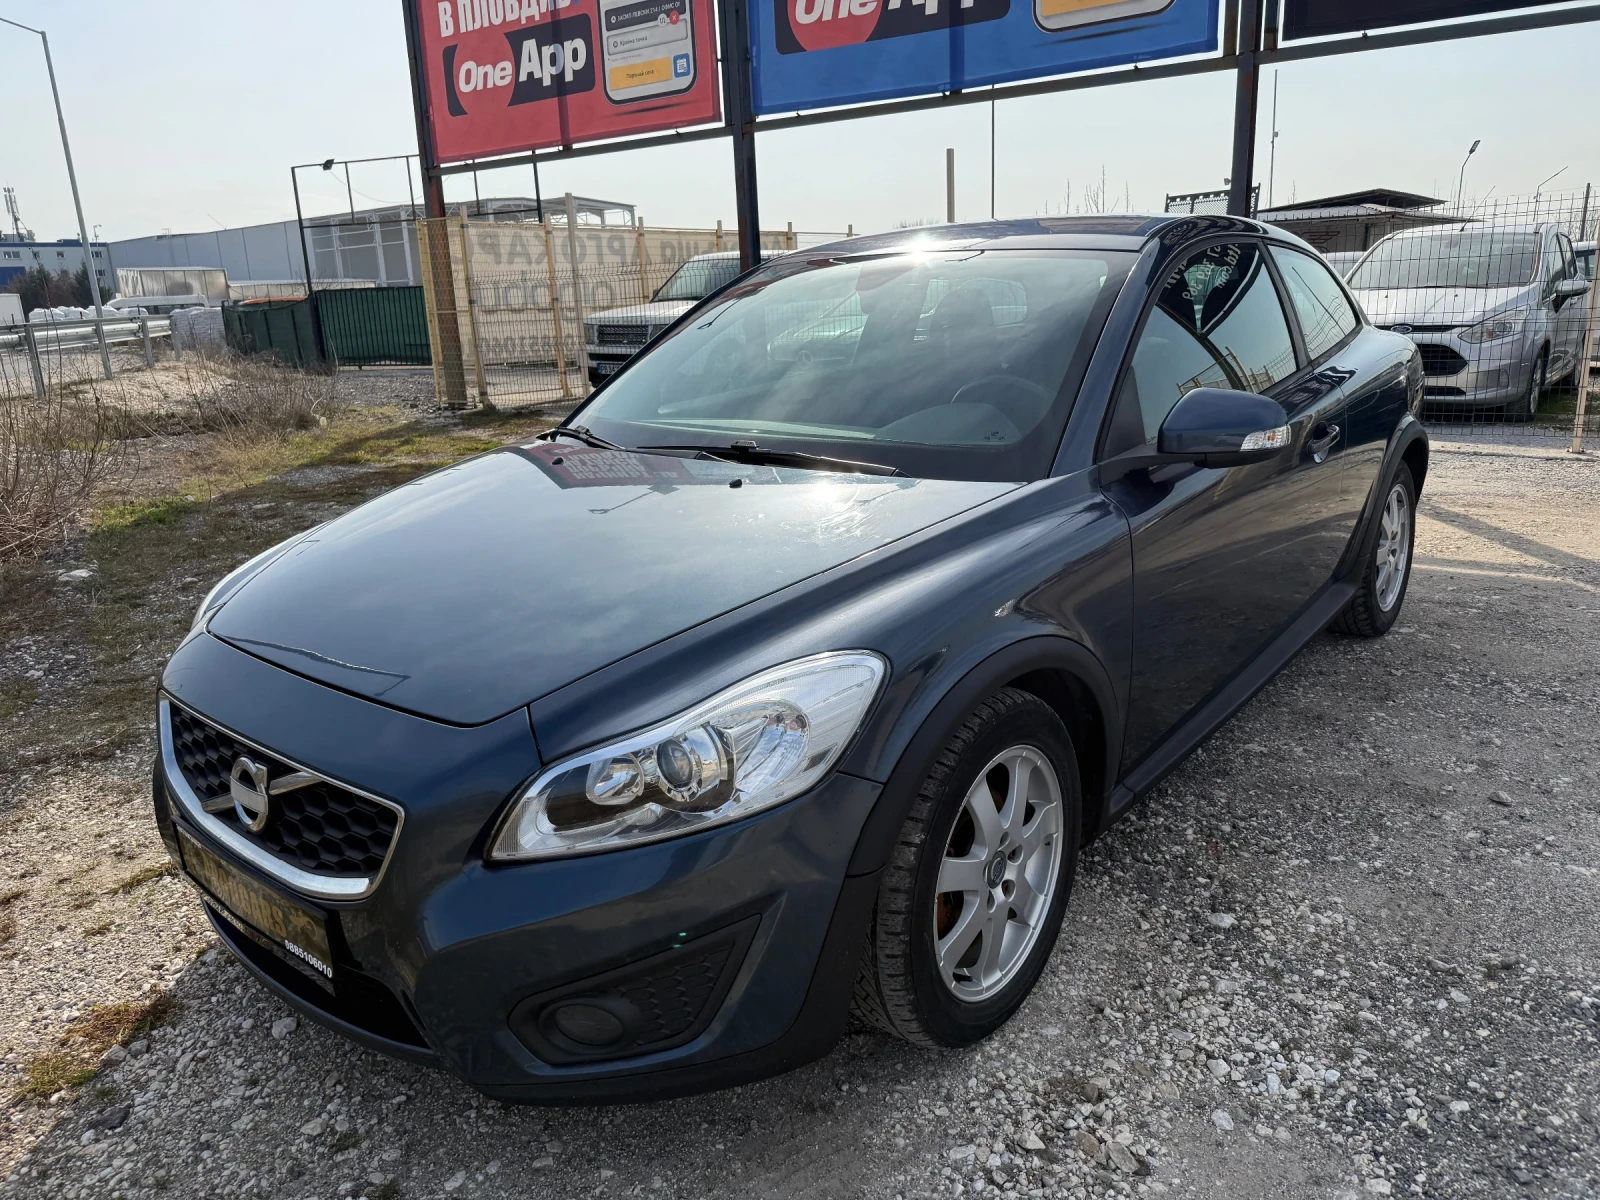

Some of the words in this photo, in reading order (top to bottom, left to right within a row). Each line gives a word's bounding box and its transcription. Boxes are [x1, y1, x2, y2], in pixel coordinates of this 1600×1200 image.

[438, 2, 454, 38] В
[458, 59, 513, 94] One
[518, 37, 588, 88] App
[283, 938, 334, 980] 0885106010
